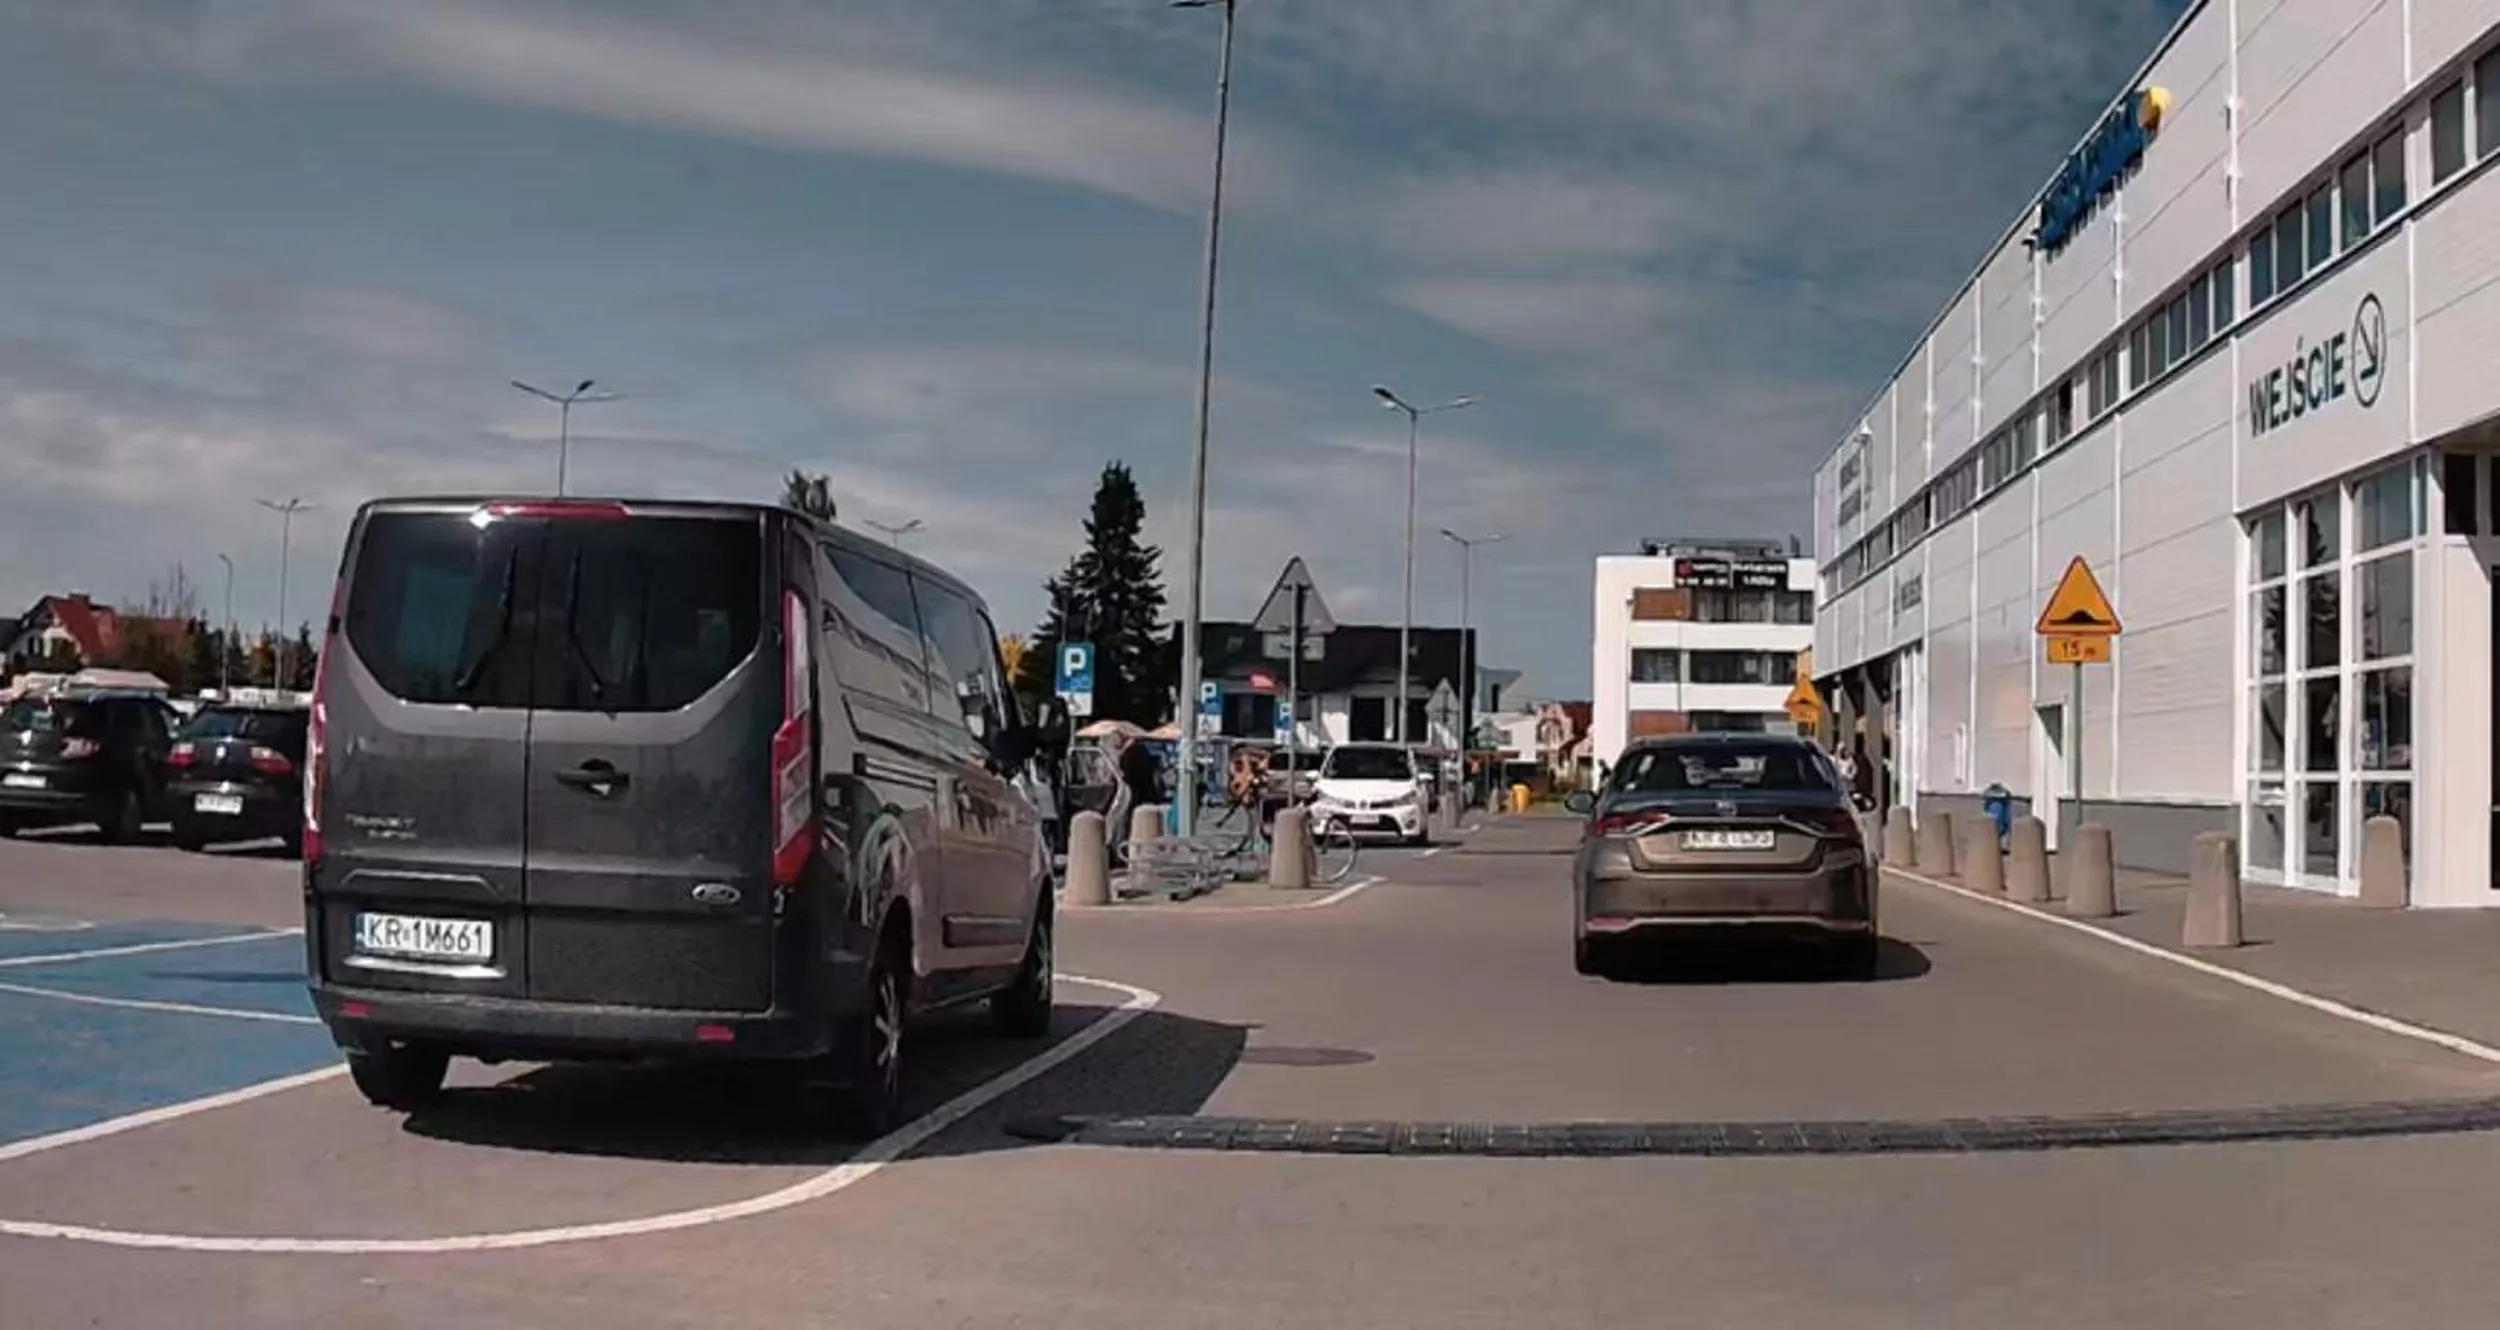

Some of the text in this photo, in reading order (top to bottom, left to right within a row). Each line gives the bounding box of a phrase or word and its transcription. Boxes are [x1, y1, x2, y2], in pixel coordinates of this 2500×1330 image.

[2250, 332, 2346, 438] WEJŚCIE
[1065, 647, 1087, 677] P
[2062, 640, 2079, 657] 15
[1202, 682, 1217, 704] P
[367, 917, 482, 952] KR 1M661
